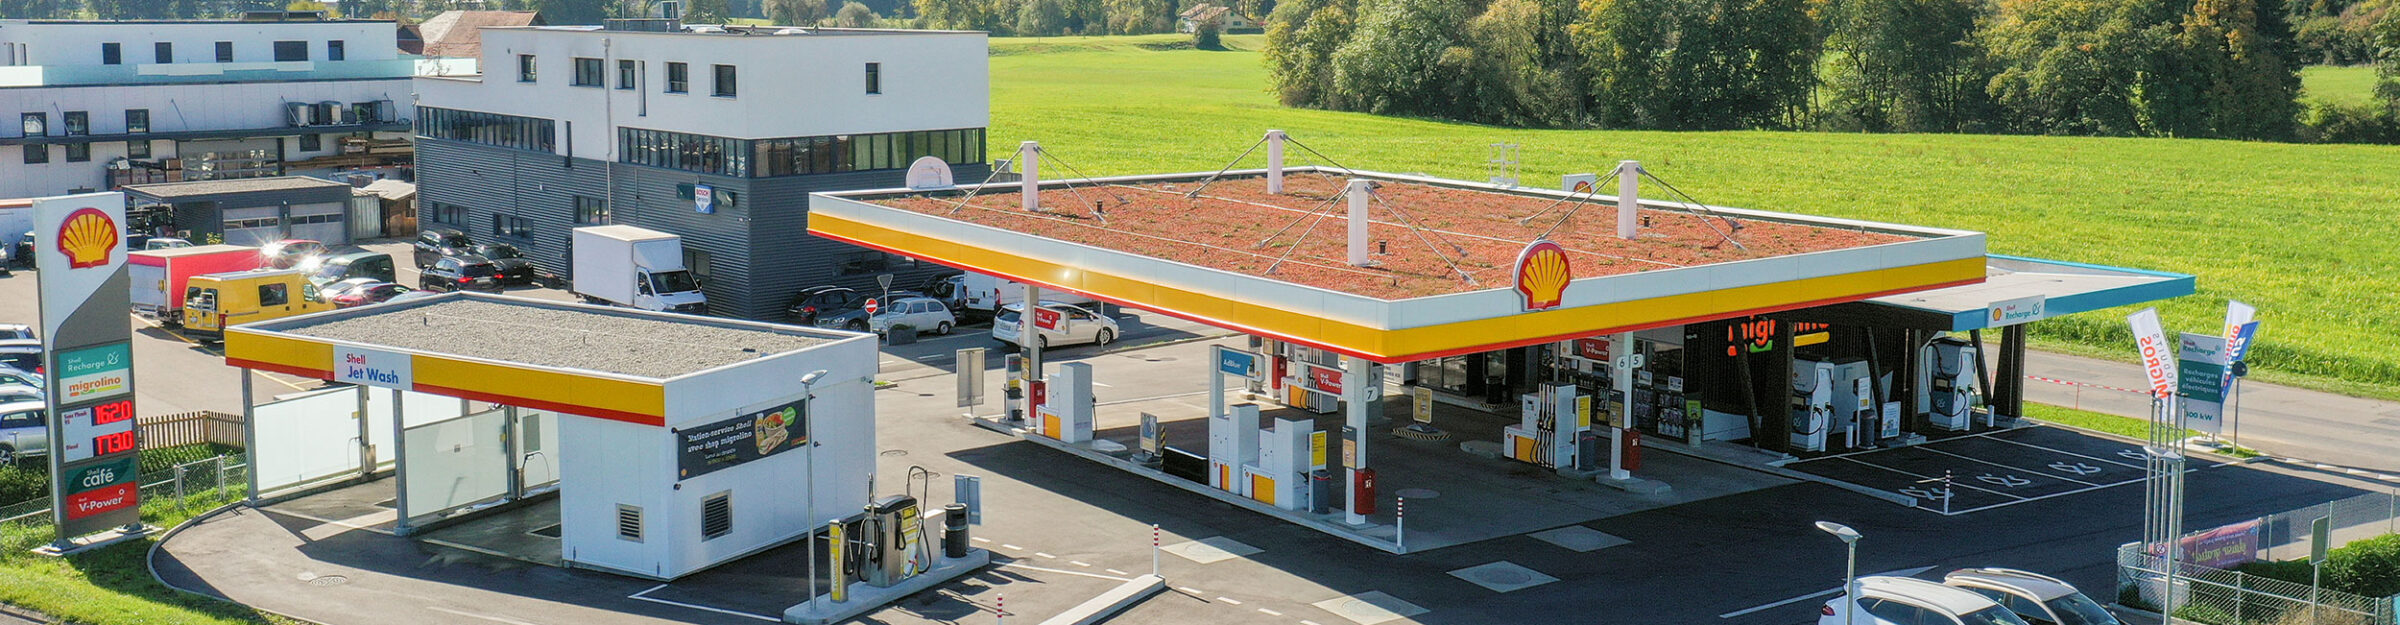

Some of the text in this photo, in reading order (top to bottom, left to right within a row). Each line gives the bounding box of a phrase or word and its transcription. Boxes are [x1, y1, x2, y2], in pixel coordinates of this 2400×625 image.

[2005, 311, 2031, 320] Recharge
[2183, 344, 2216, 356] Recharge
[67, 357, 82, 365] Shell
[346, 353, 366, 365] Shell
[1619, 355, 1639, 368] 6 5
[67, 360, 105, 373] Recharge
[348, 366, 399, 384] Jet Wash
[2183, 367, 2218, 380] Recharges
[69, 376, 121, 392] migrolino
[2185, 376, 2216, 386] véhicules
[1366, 389, 1373, 400] 7
[2182, 383, 2219, 395] électriques
[2199, 412, 2213, 421] kW
[735, 420, 752, 431] Shell
[687, 430, 753, 453] avec shop migrolino
[83, 468, 114, 487] café
[86, 468, 99, 476] Shell
[78, 496, 124, 512] V-Power
